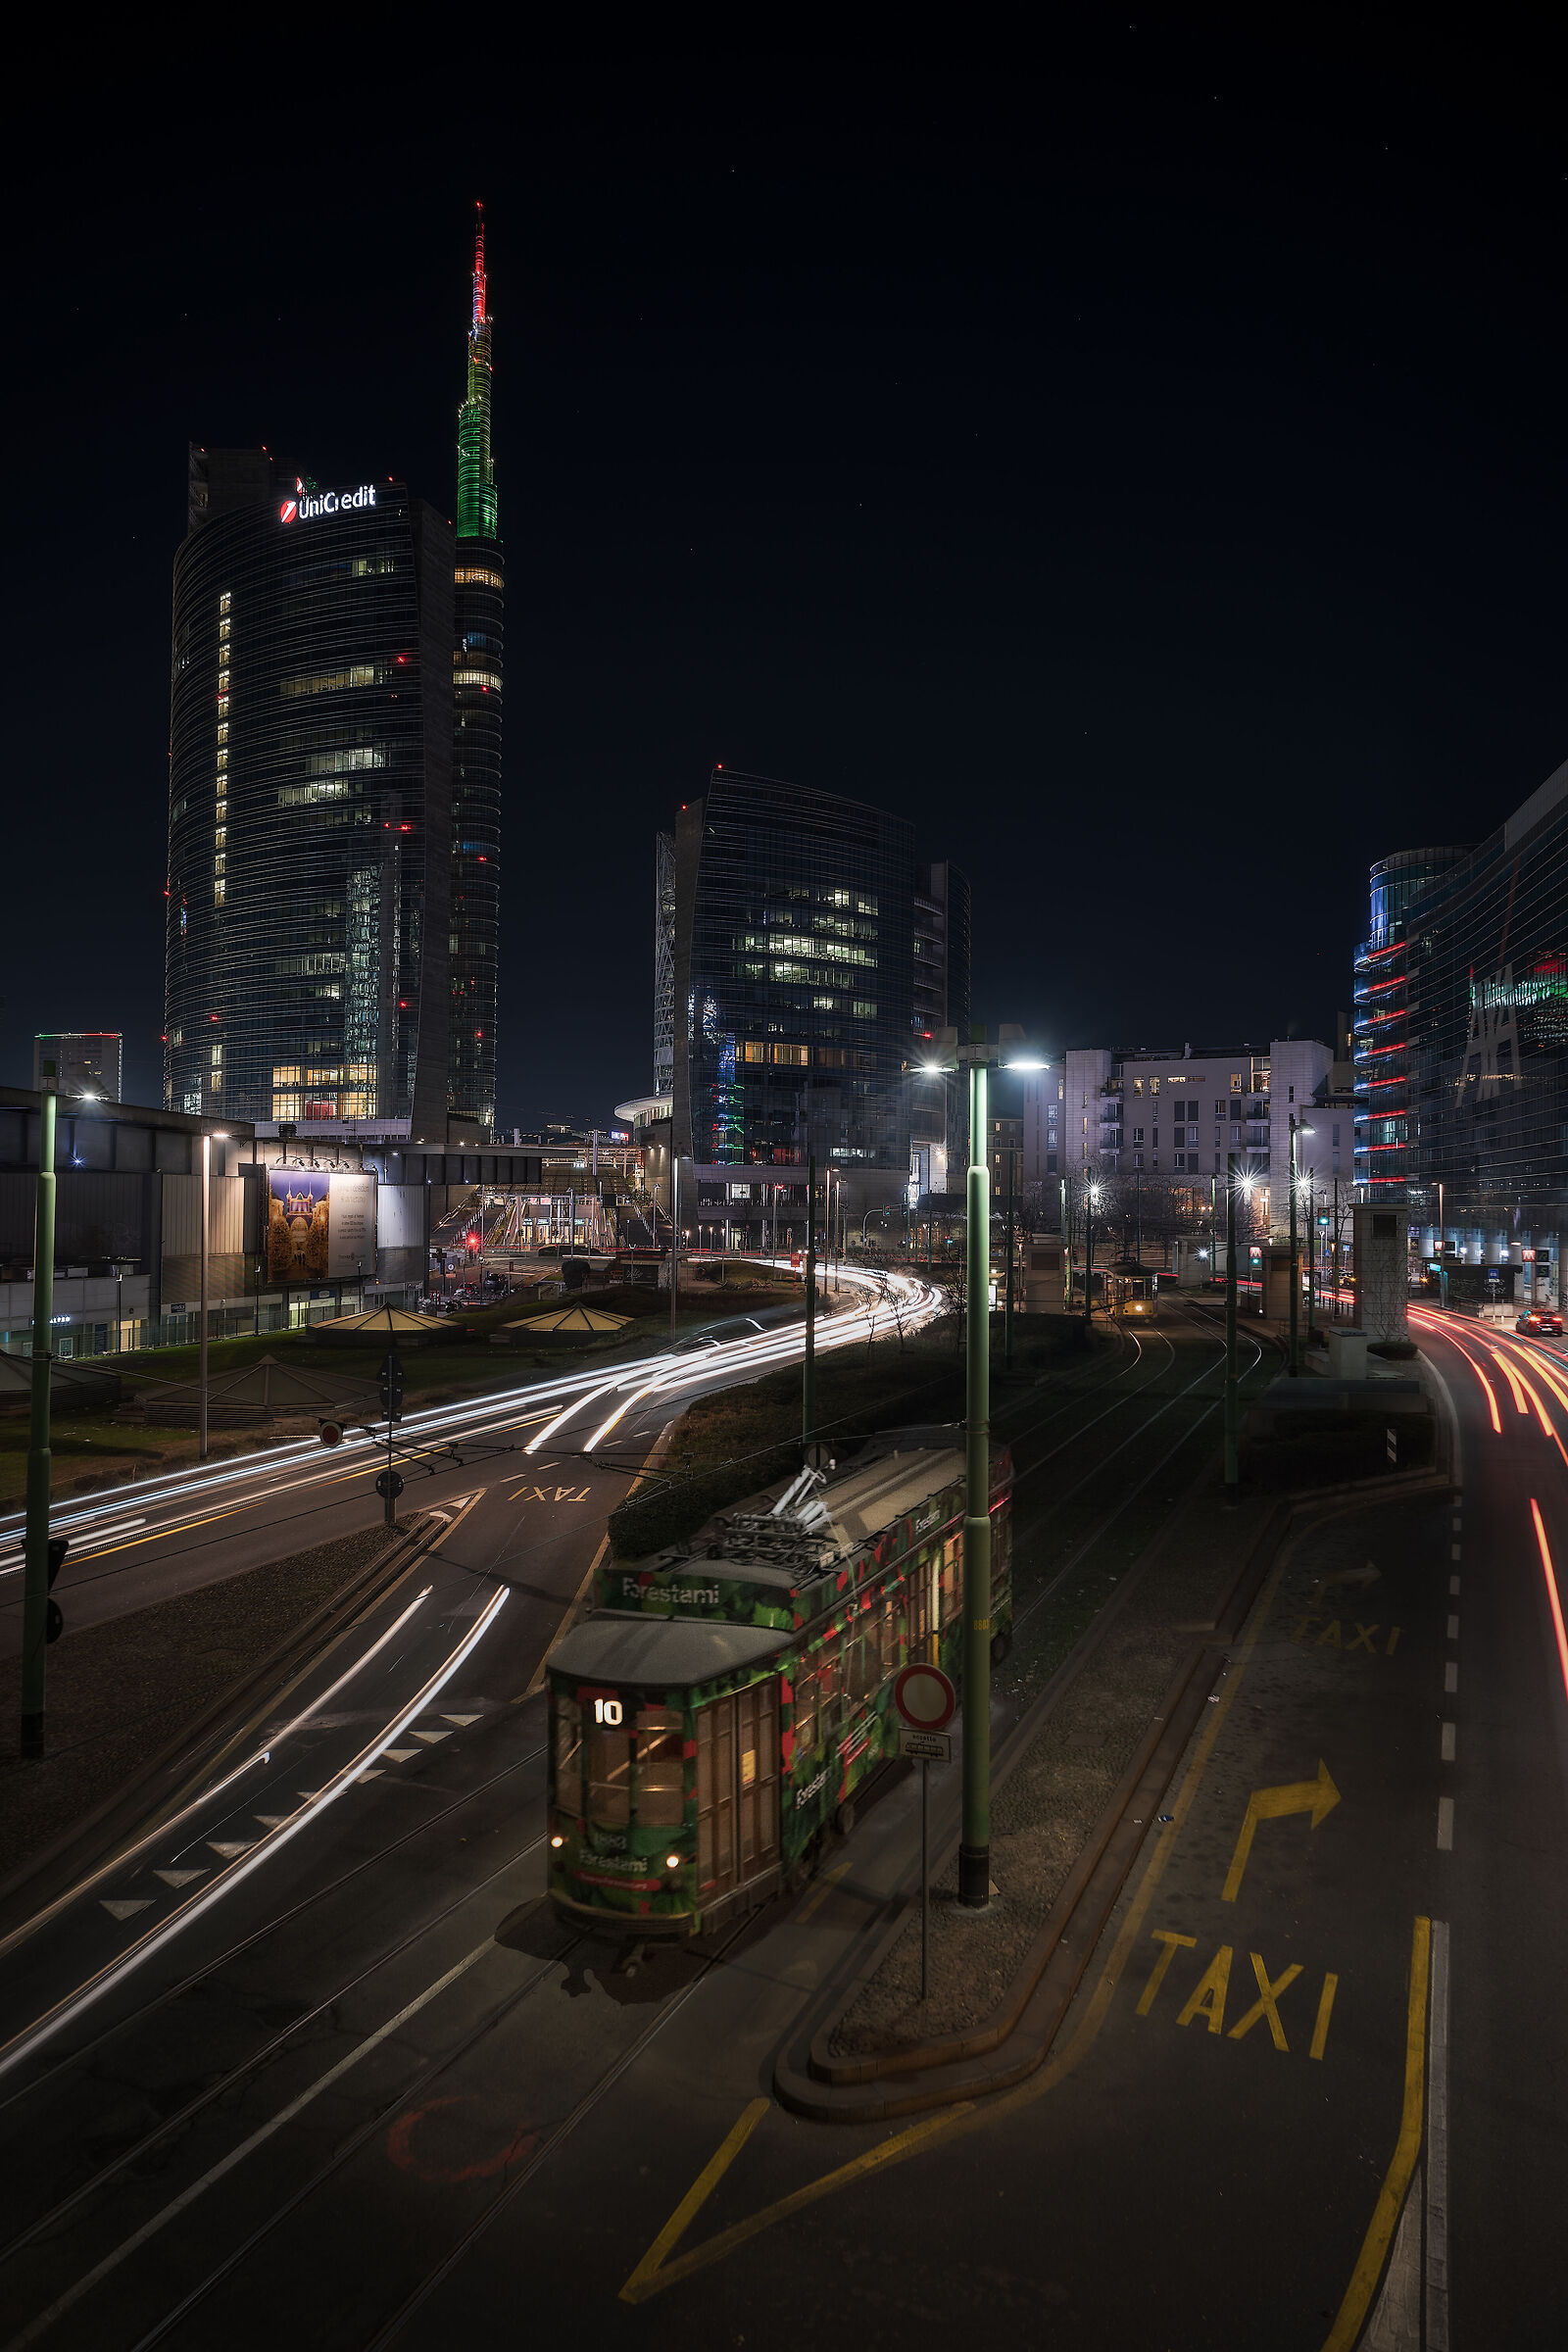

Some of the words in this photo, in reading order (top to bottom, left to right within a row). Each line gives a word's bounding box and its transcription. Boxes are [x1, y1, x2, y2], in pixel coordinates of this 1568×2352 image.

[298, 483, 376, 519] UniCredit
[1523, 1251, 1536, 1260] M
[507, 1487, 592, 1502] TAXI
[621, 1576, 719, 1604] Forestami
[1293, 1615, 1403, 1656] TAXI
[594, 1698, 623, 1726] 10
[795, 1766, 833, 1810] Forestami
[579, 1849, 648, 1873] Forestami
[1135, 1929, 1339, 2061] TAXI
